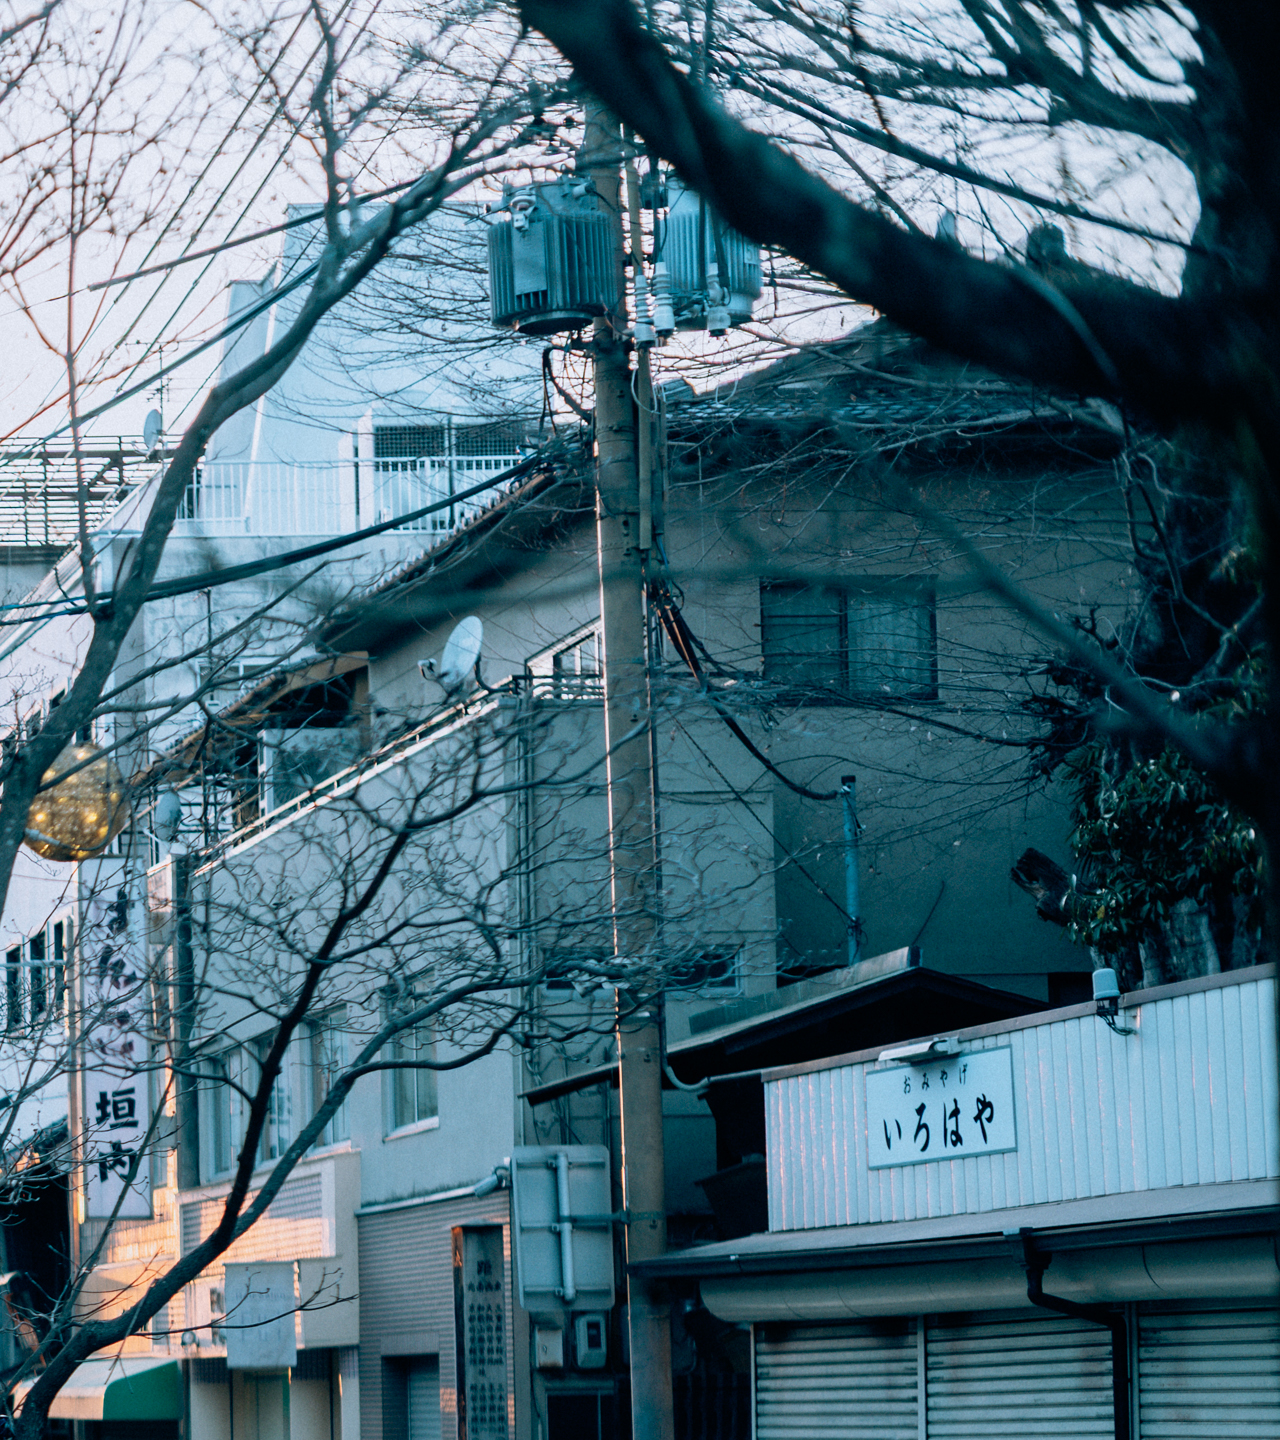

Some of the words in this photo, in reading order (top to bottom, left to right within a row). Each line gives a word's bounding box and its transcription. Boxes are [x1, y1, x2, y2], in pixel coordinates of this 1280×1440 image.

[903, 1063, 968, 1095] おみやげ
[883, 1093, 994, 1152] いろはや
